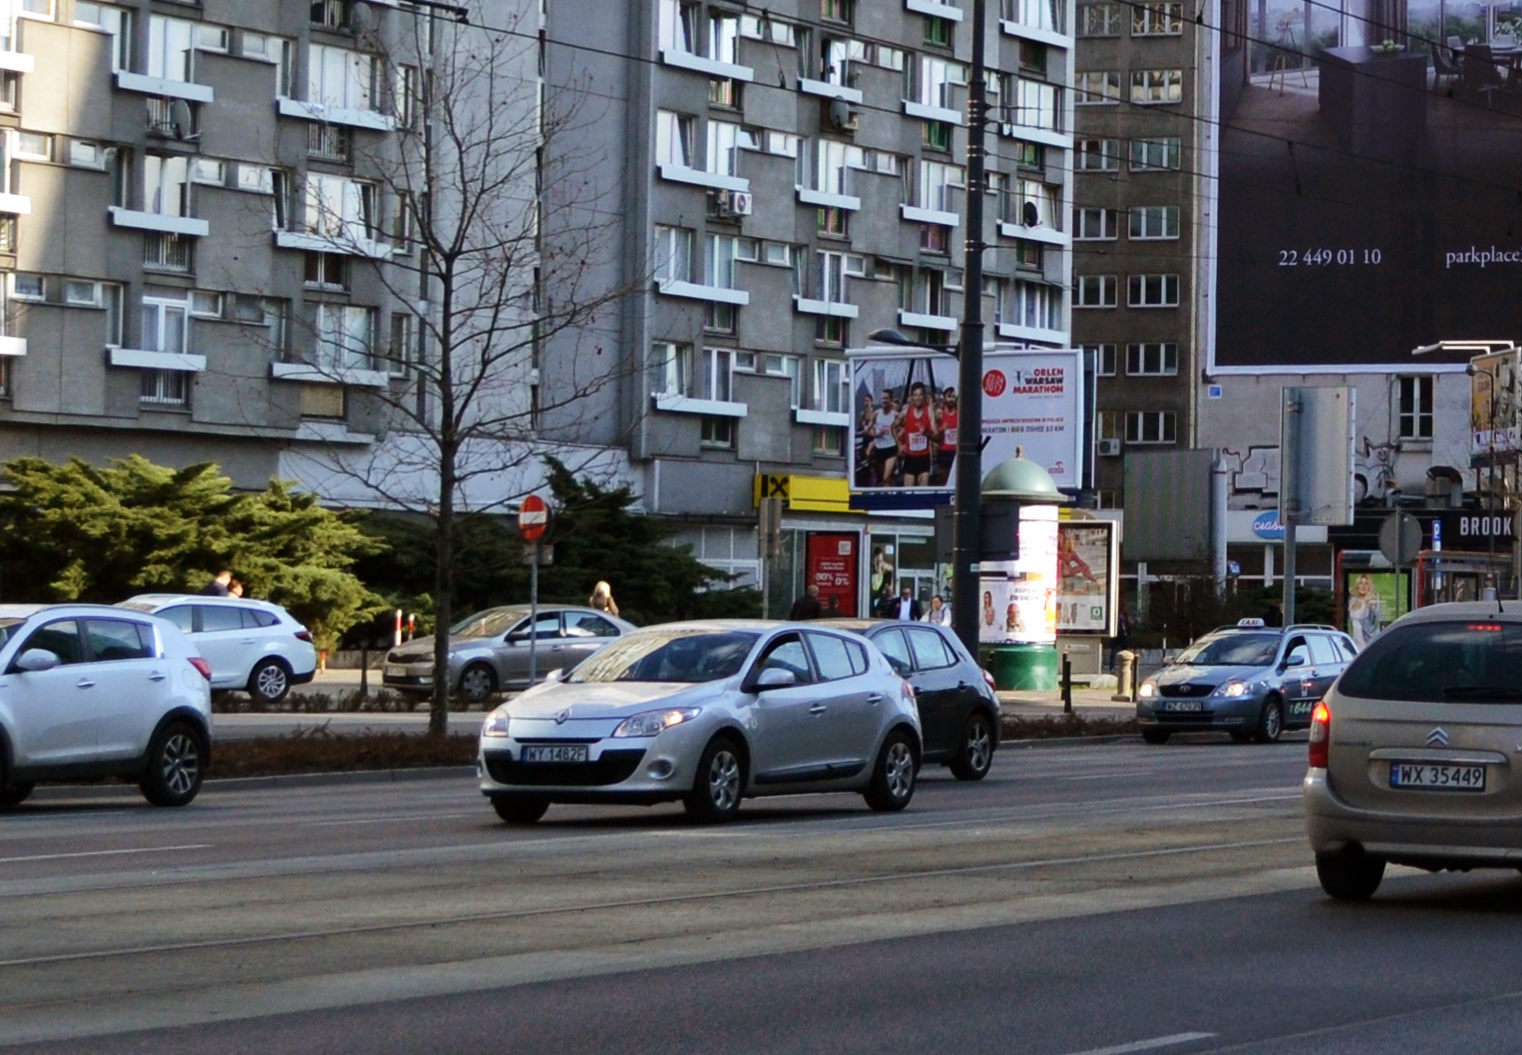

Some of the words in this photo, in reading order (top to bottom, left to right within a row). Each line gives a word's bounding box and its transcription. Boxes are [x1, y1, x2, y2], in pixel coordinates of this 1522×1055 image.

[1279, 250, 1298, 266] 22
[1303, 248, 1332, 266] 449
[1337, 249, 1355, 265] 01
[1363, 248, 1381, 265] 10
[1034, 368, 1064, 376] ORLEN
[1024, 377, 1064, 385] WARSAW
[1013, 385, 1064, 394] MARATHON
[529, 747, 545, 761] WY
[1401, 767, 1424, 784] WX
[1431, 767, 1482, 786] 35449
